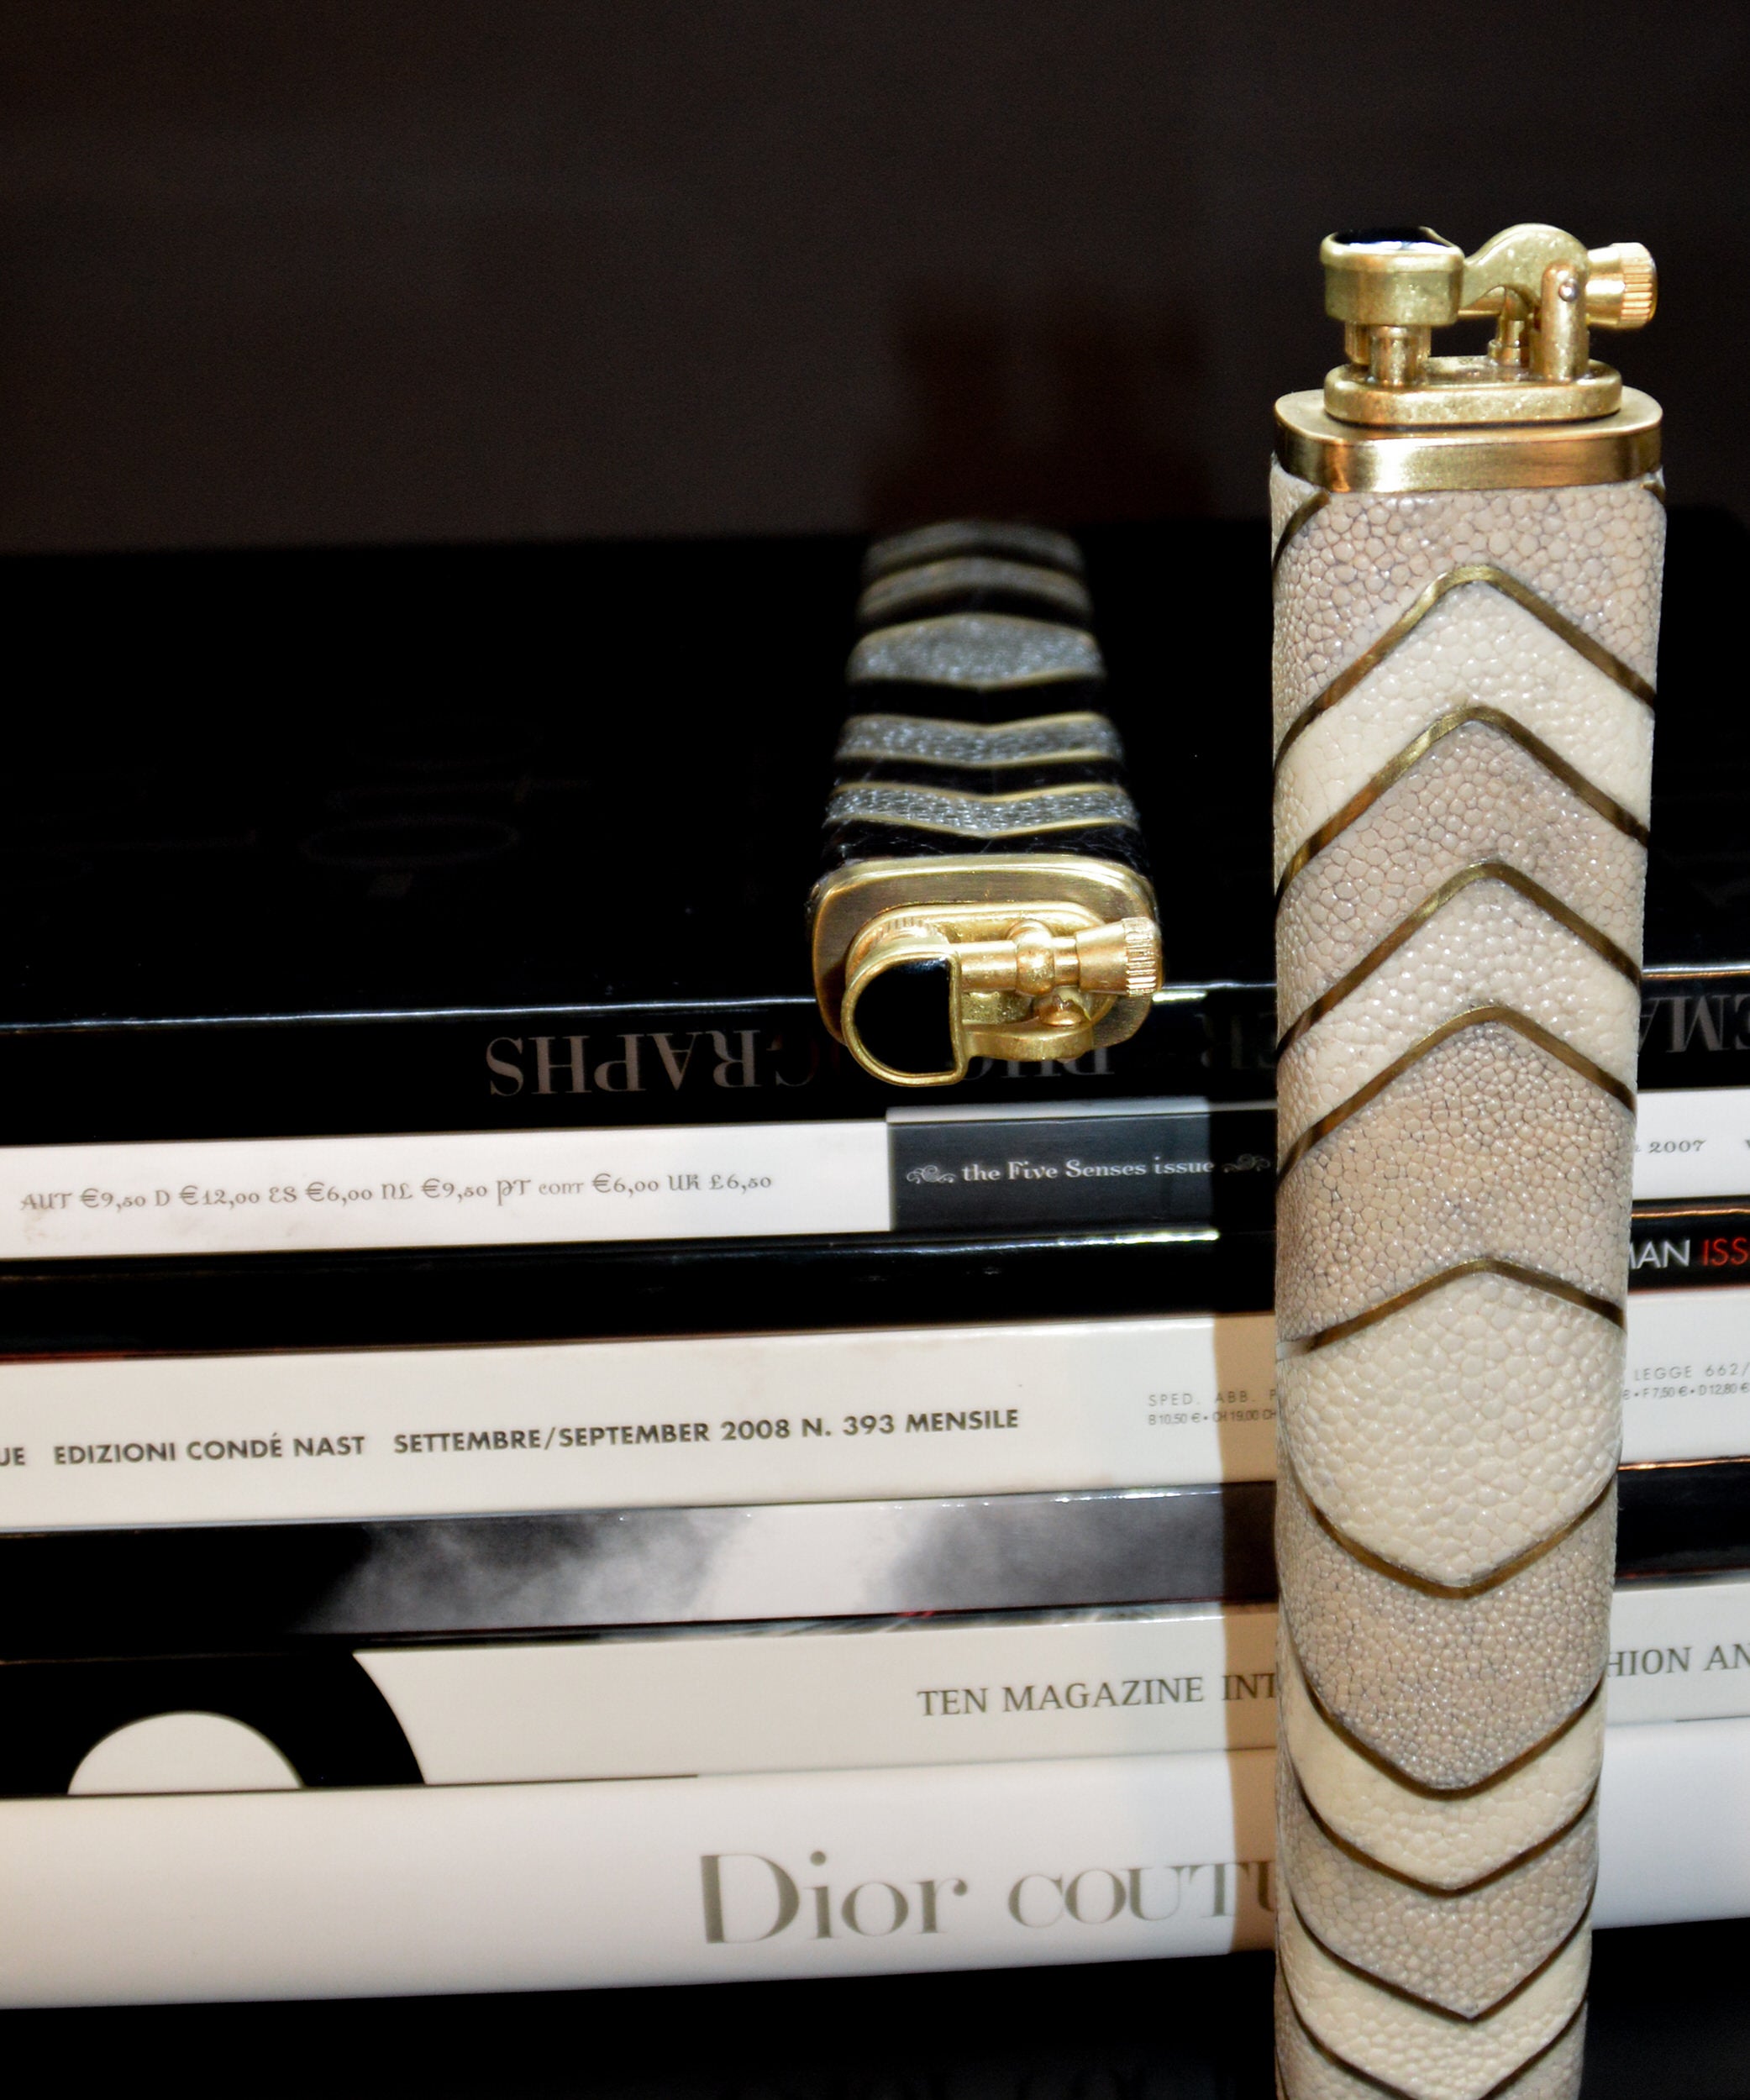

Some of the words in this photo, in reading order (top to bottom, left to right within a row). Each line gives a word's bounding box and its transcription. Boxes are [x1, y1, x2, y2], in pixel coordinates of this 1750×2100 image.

[1648, 1139, 1706, 1154] 2007
[962, 1163, 1001, 1182] the
[1007, 1160, 1058, 1179] Five
[1065, 1158, 1147, 1178] Senses
[1154, 1155, 1215, 1174] issue
[21, 1192, 72, 1210] AUT
[155, 1189, 171, 1207] D
[269, 1186, 297, 1204] ES
[305, 1181, 372, 1206] €6,00
[592, 1173, 659, 1198] €6,00
[667, 1174, 702, 1191] UK
[1634, 1365, 1693, 1382] LEGGE
[55, 1441, 176, 1465] EDIZIONI
[187, 1431, 282, 1461] CONDÉ
[294, 1436, 366, 1457] NAST
[394, 1422, 710, 1454] SETTEMBRE/SEPTEMBER
[721, 1419, 791, 1441] 2008
[801, 1417, 832, 1438] N.
[843, 1414, 896, 1436] 393
[906, 1409, 1019, 1433] MENSILE
[917, 1687, 988, 1717] TEN
[1003, 1676, 1204, 1713] MAGAZINE
[700, 1850, 968, 1945] Dior
